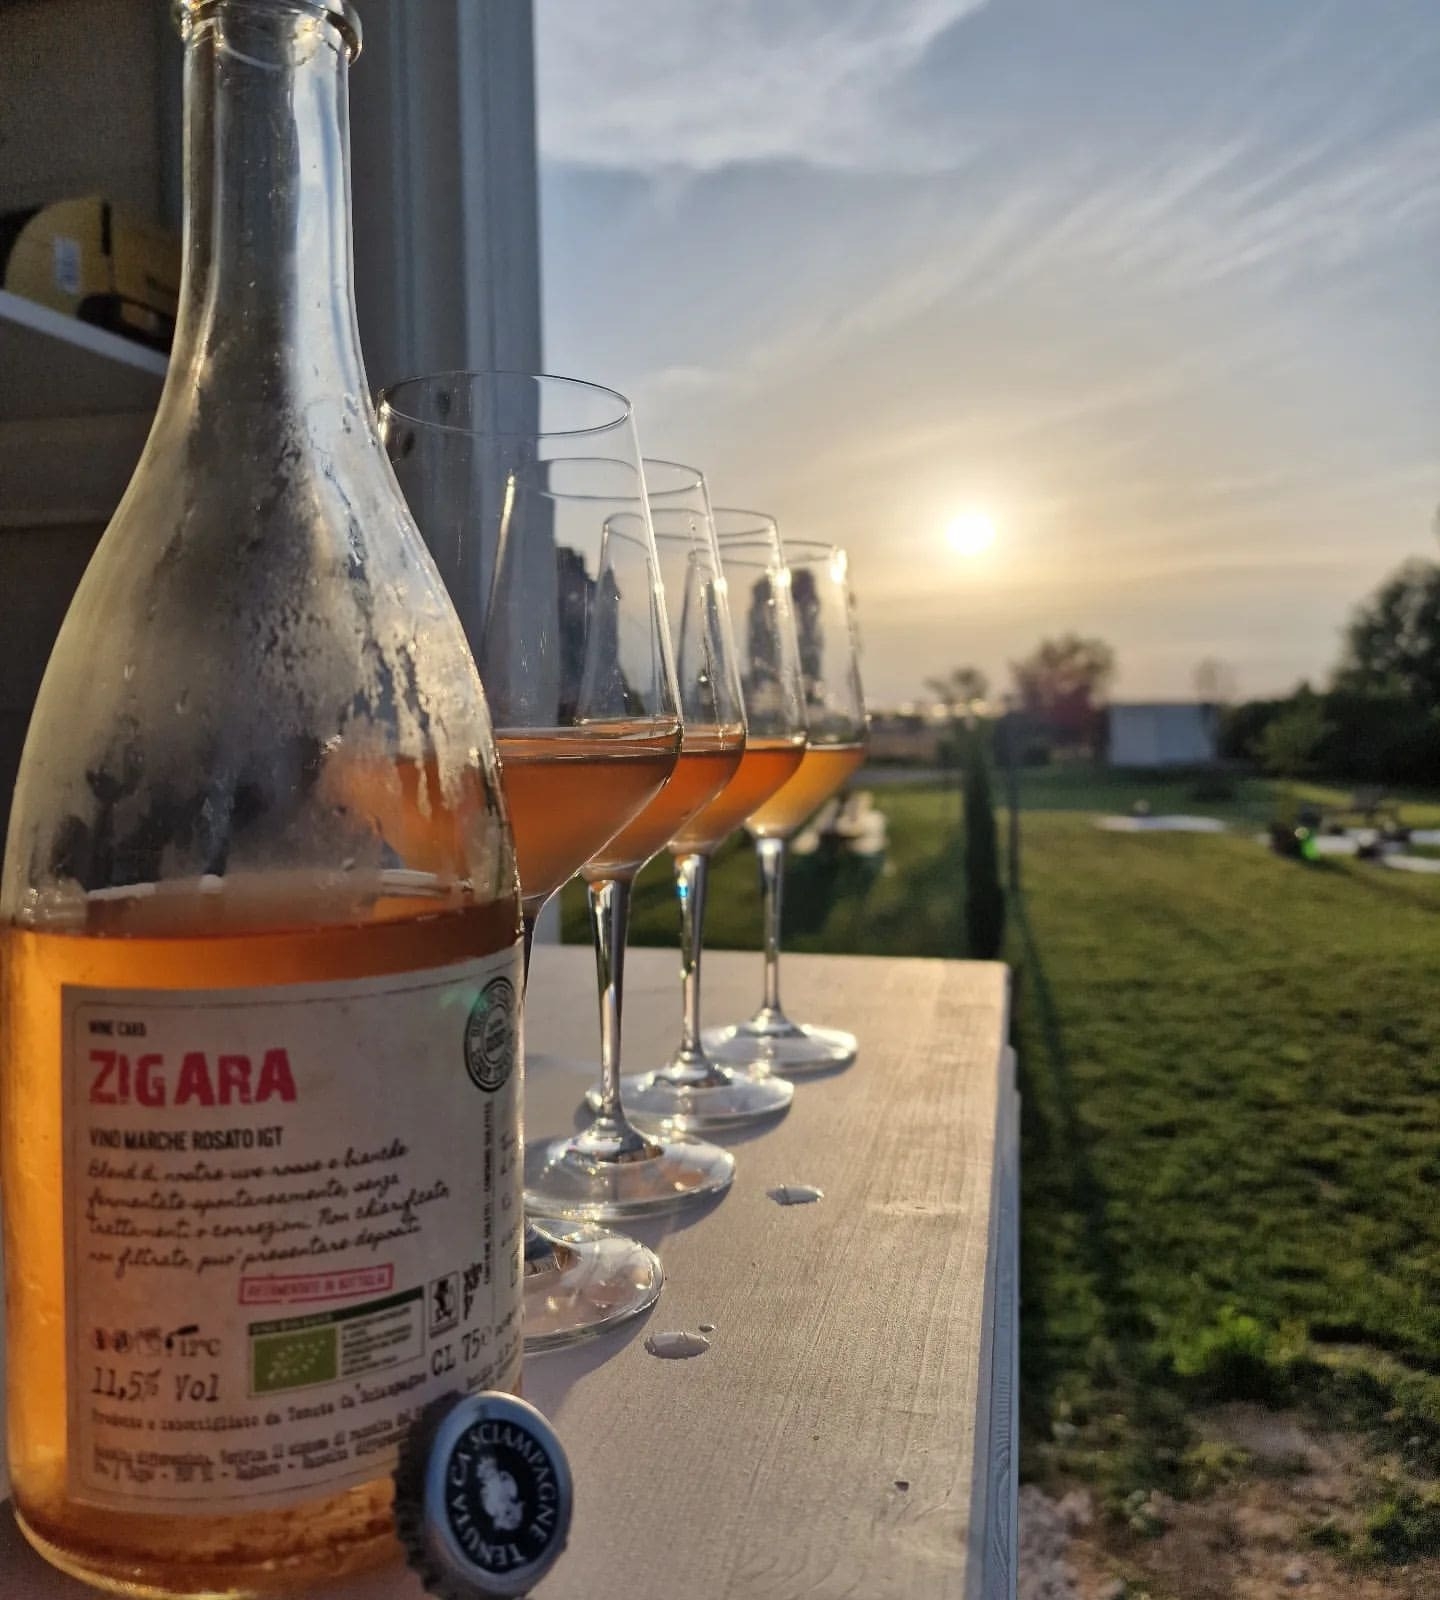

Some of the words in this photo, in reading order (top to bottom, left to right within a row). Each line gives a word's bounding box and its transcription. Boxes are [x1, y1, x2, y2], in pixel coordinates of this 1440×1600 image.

[89, 1047, 298, 1107] ZIGARA
[89, 1126, 121, 1149] VINO
[124, 1129, 188, 1151] MARCHE
[192, 1127, 254, 1150] ROSATO
[257, 1124, 284, 1148] IGT
[344, 1136, 410, 1169] bianche
[352, 1172, 400, 1198] senza
[431, 1343, 457, 1377] CL
[91, 1366, 163, 1402] 11,5%
[174, 1373, 220, 1403] Vol
[468, 1423, 557, 1543] SCIAMPAGNE
[451, 1493, 528, 1566] TENUTA
